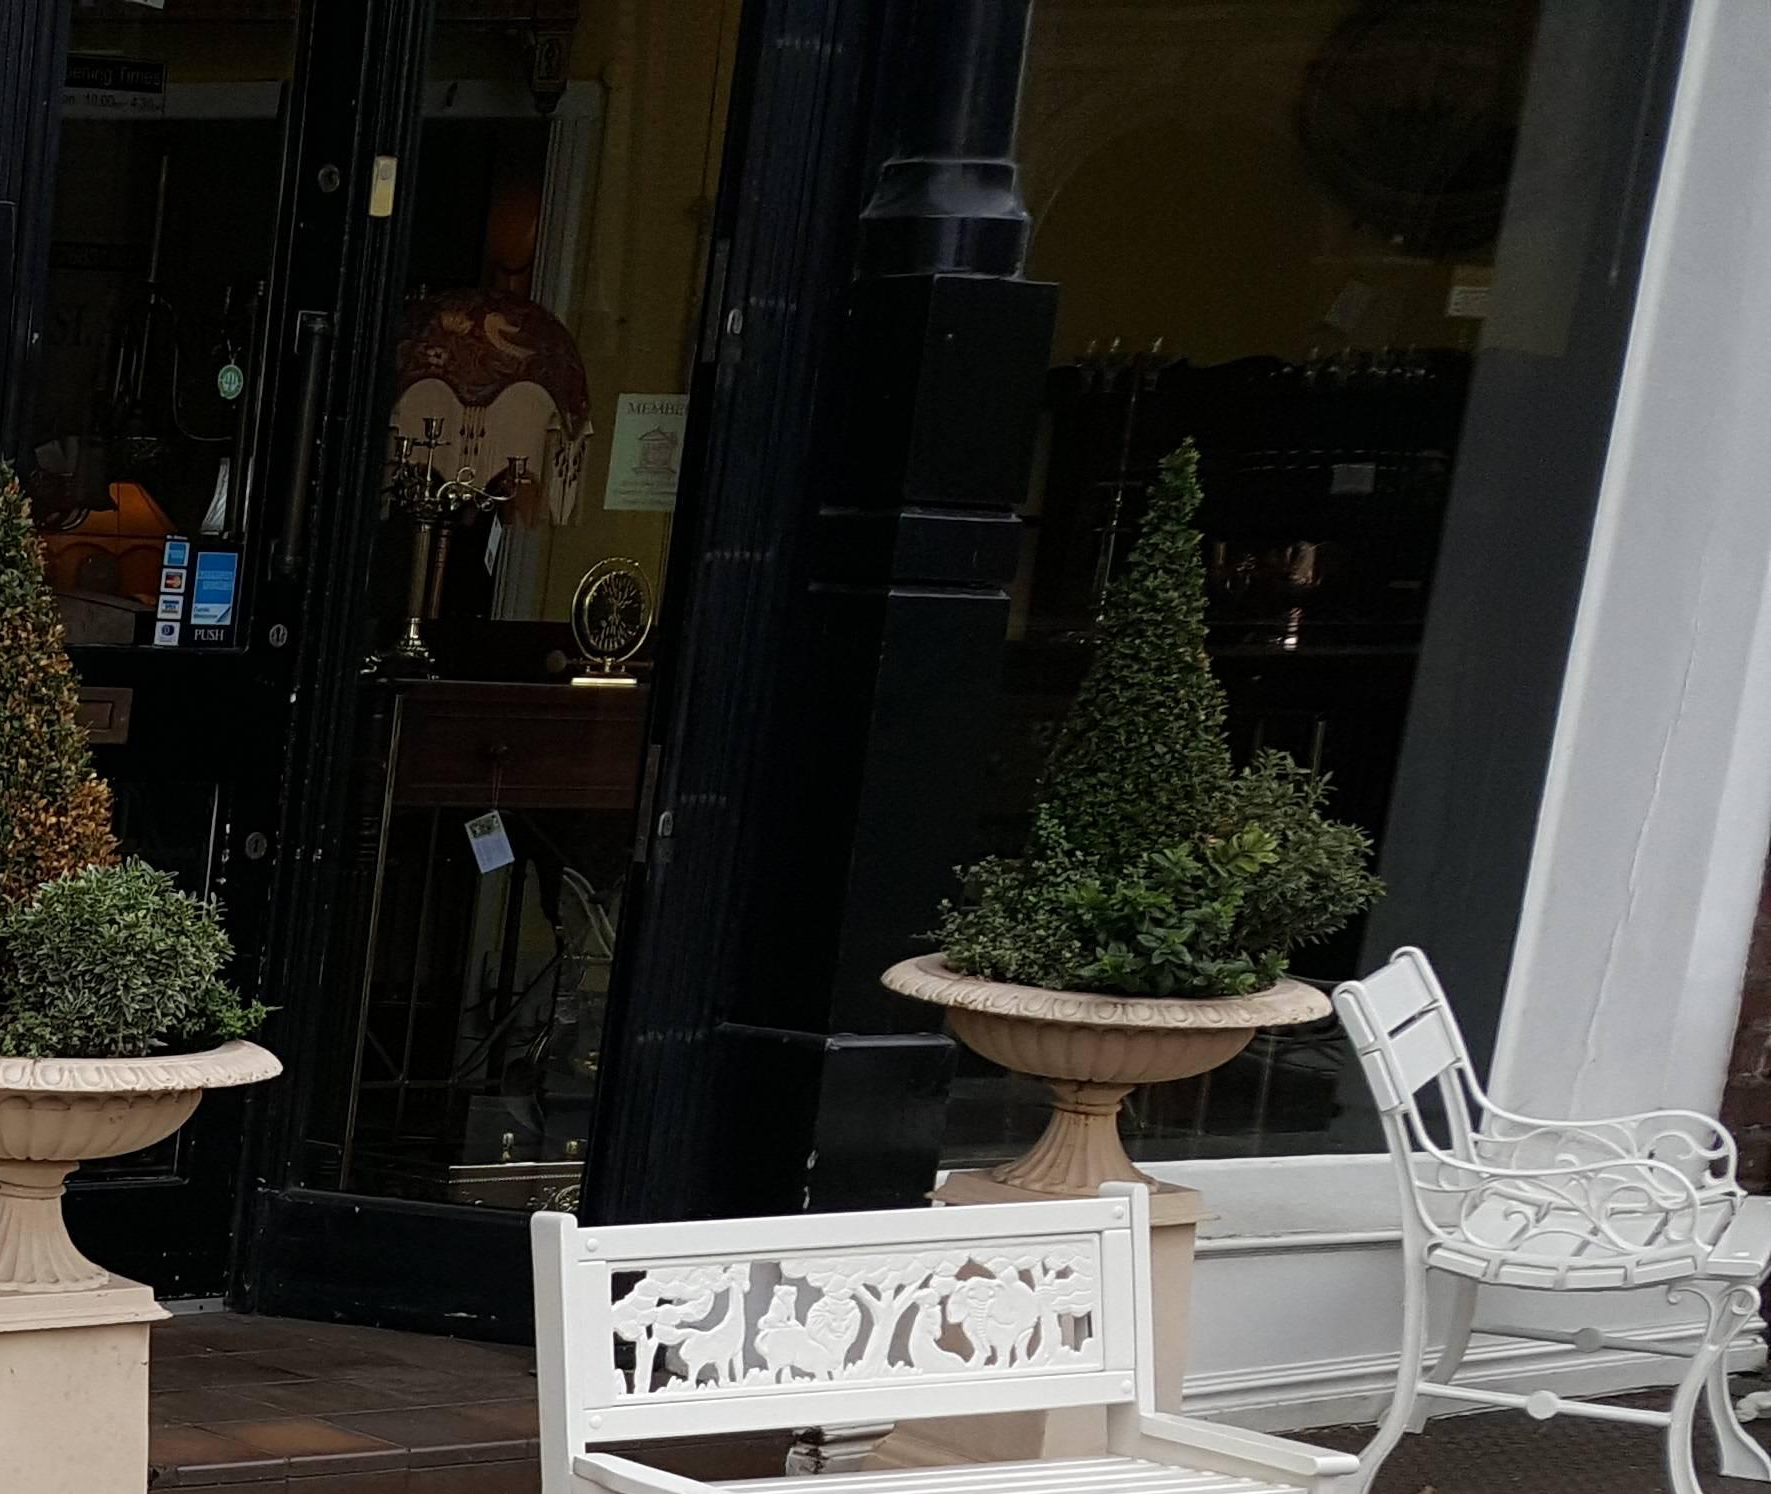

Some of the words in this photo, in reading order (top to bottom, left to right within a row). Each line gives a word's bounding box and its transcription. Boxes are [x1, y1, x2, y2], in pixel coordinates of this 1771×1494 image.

[119, 65, 162, 86] Times
[627, 401, 685, 417] MEMBE
[194, 628, 225, 641] PUSH
